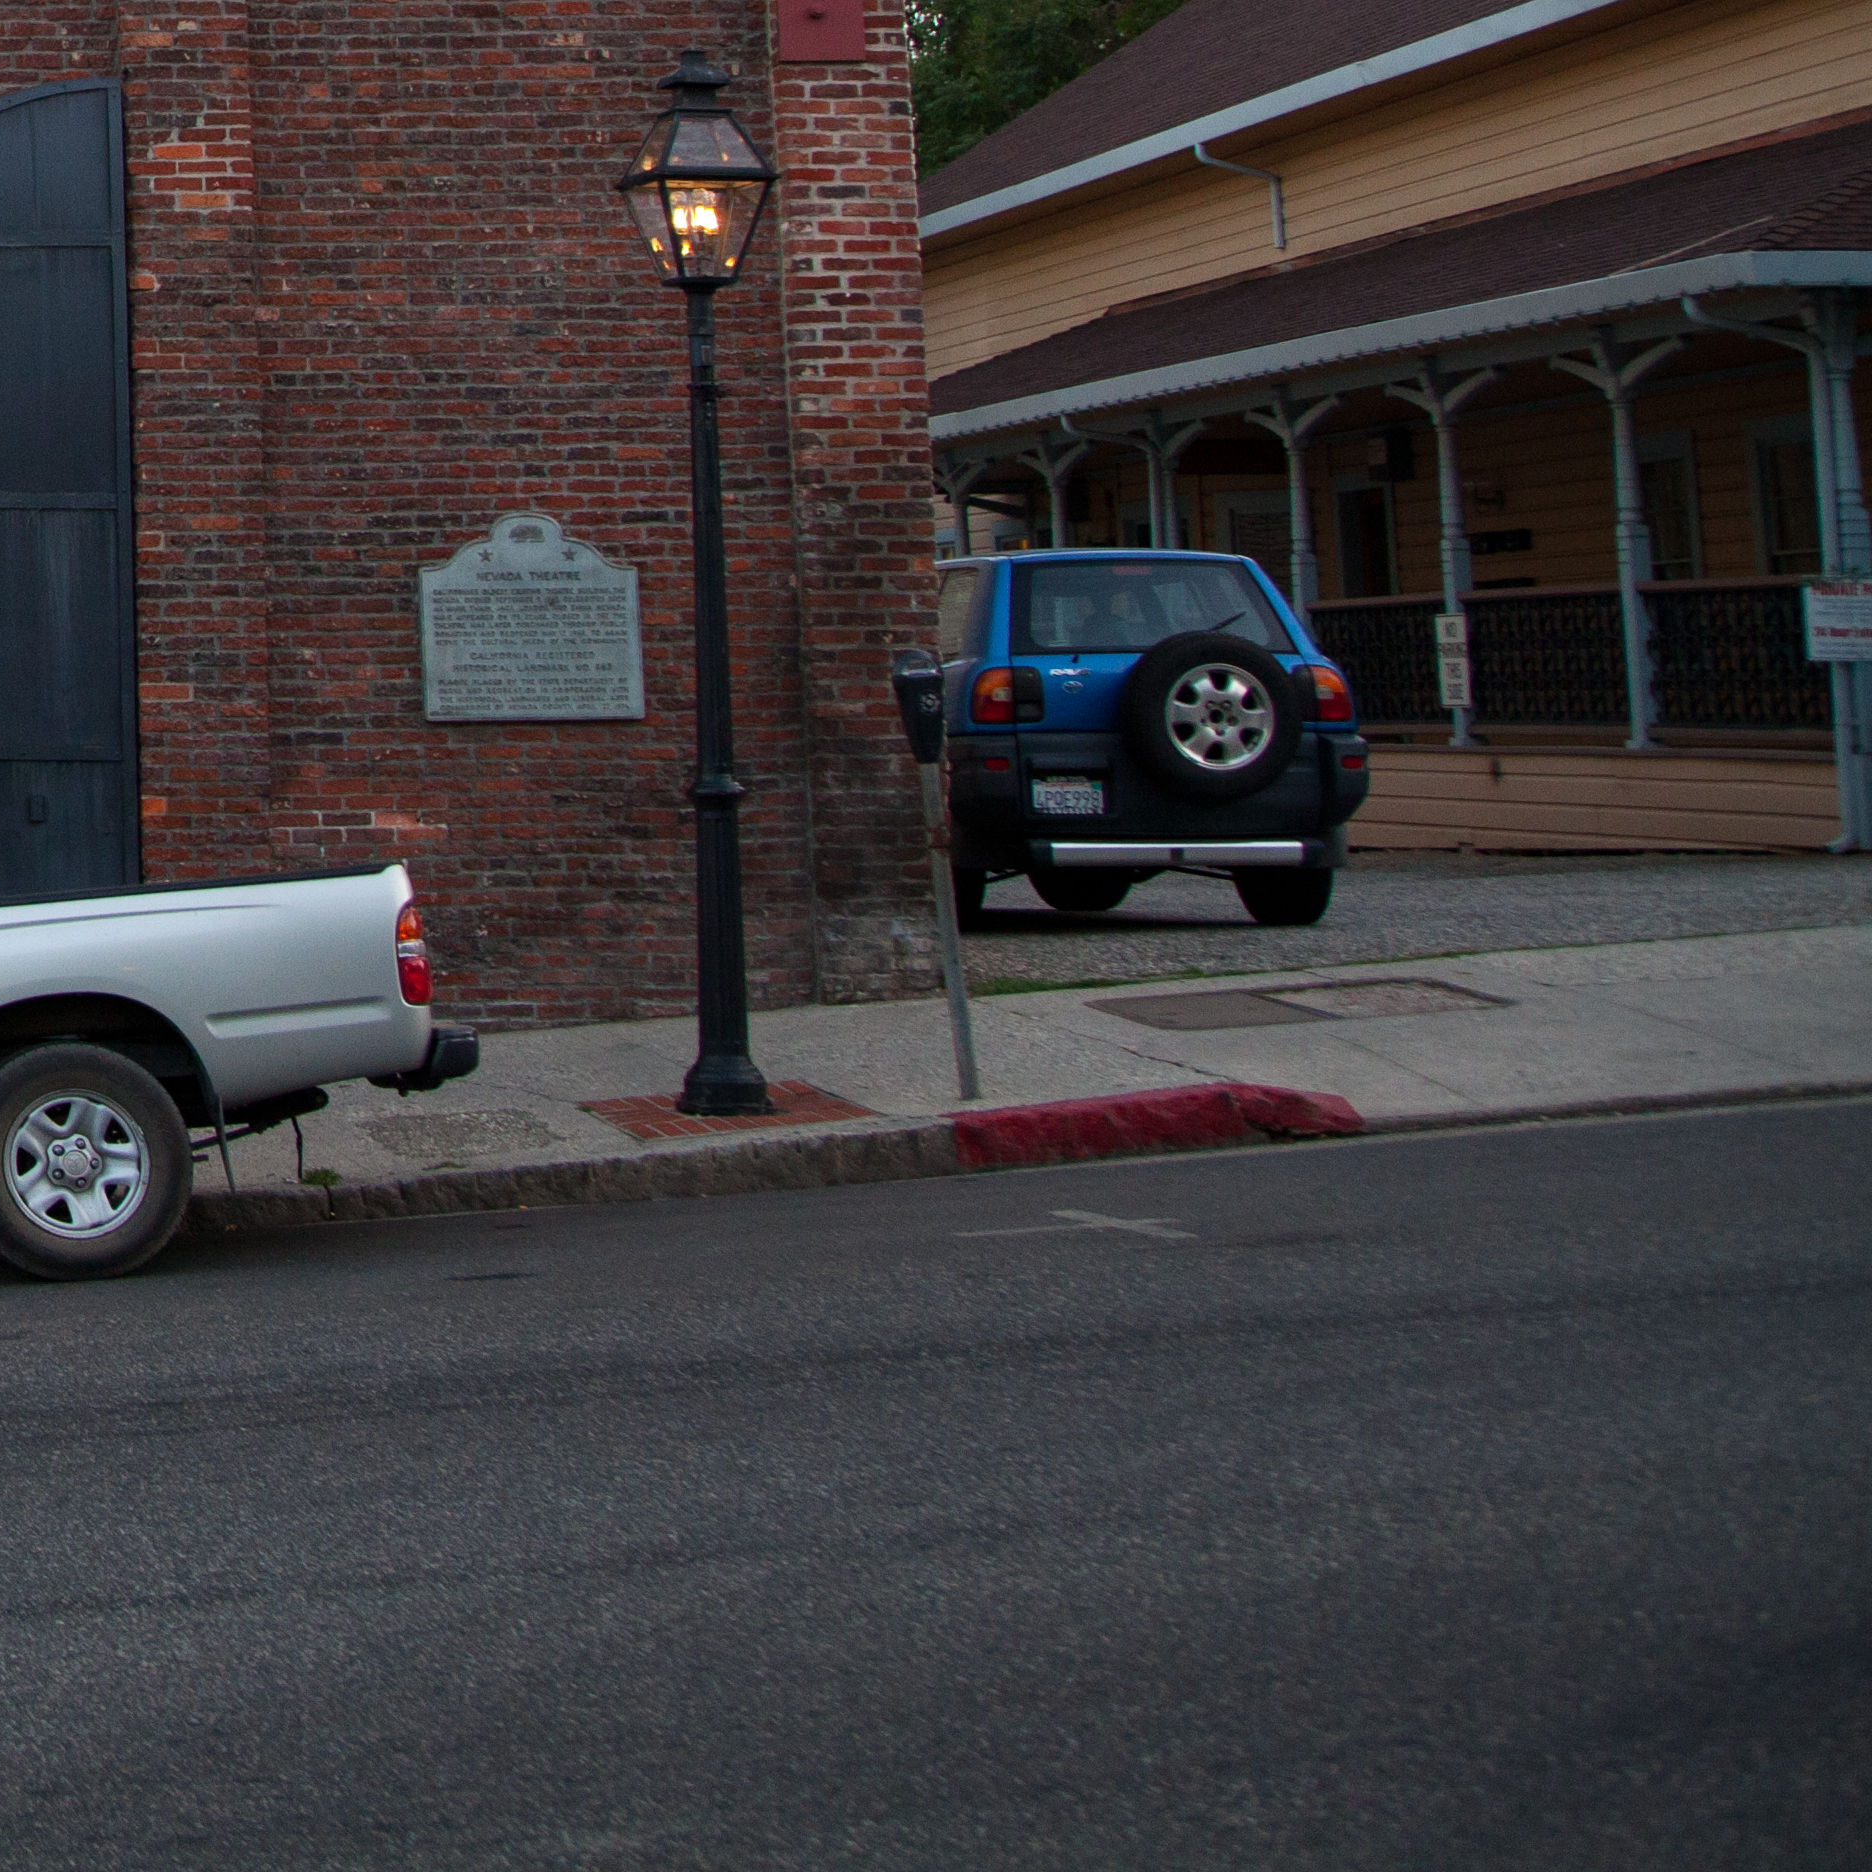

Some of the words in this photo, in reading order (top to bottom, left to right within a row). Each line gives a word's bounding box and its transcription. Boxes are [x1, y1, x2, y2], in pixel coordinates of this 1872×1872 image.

[476, 572, 523, 582] NEVADA
[528, 571, 582, 581] THEATRE
[469, 651, 530, 660] CALIFORNIA
[535, 651, 596, 660] REGISTERED
[452, 663, 512, 672] HISTORICAL
[516, 663, 570, 672] LANDMARK
